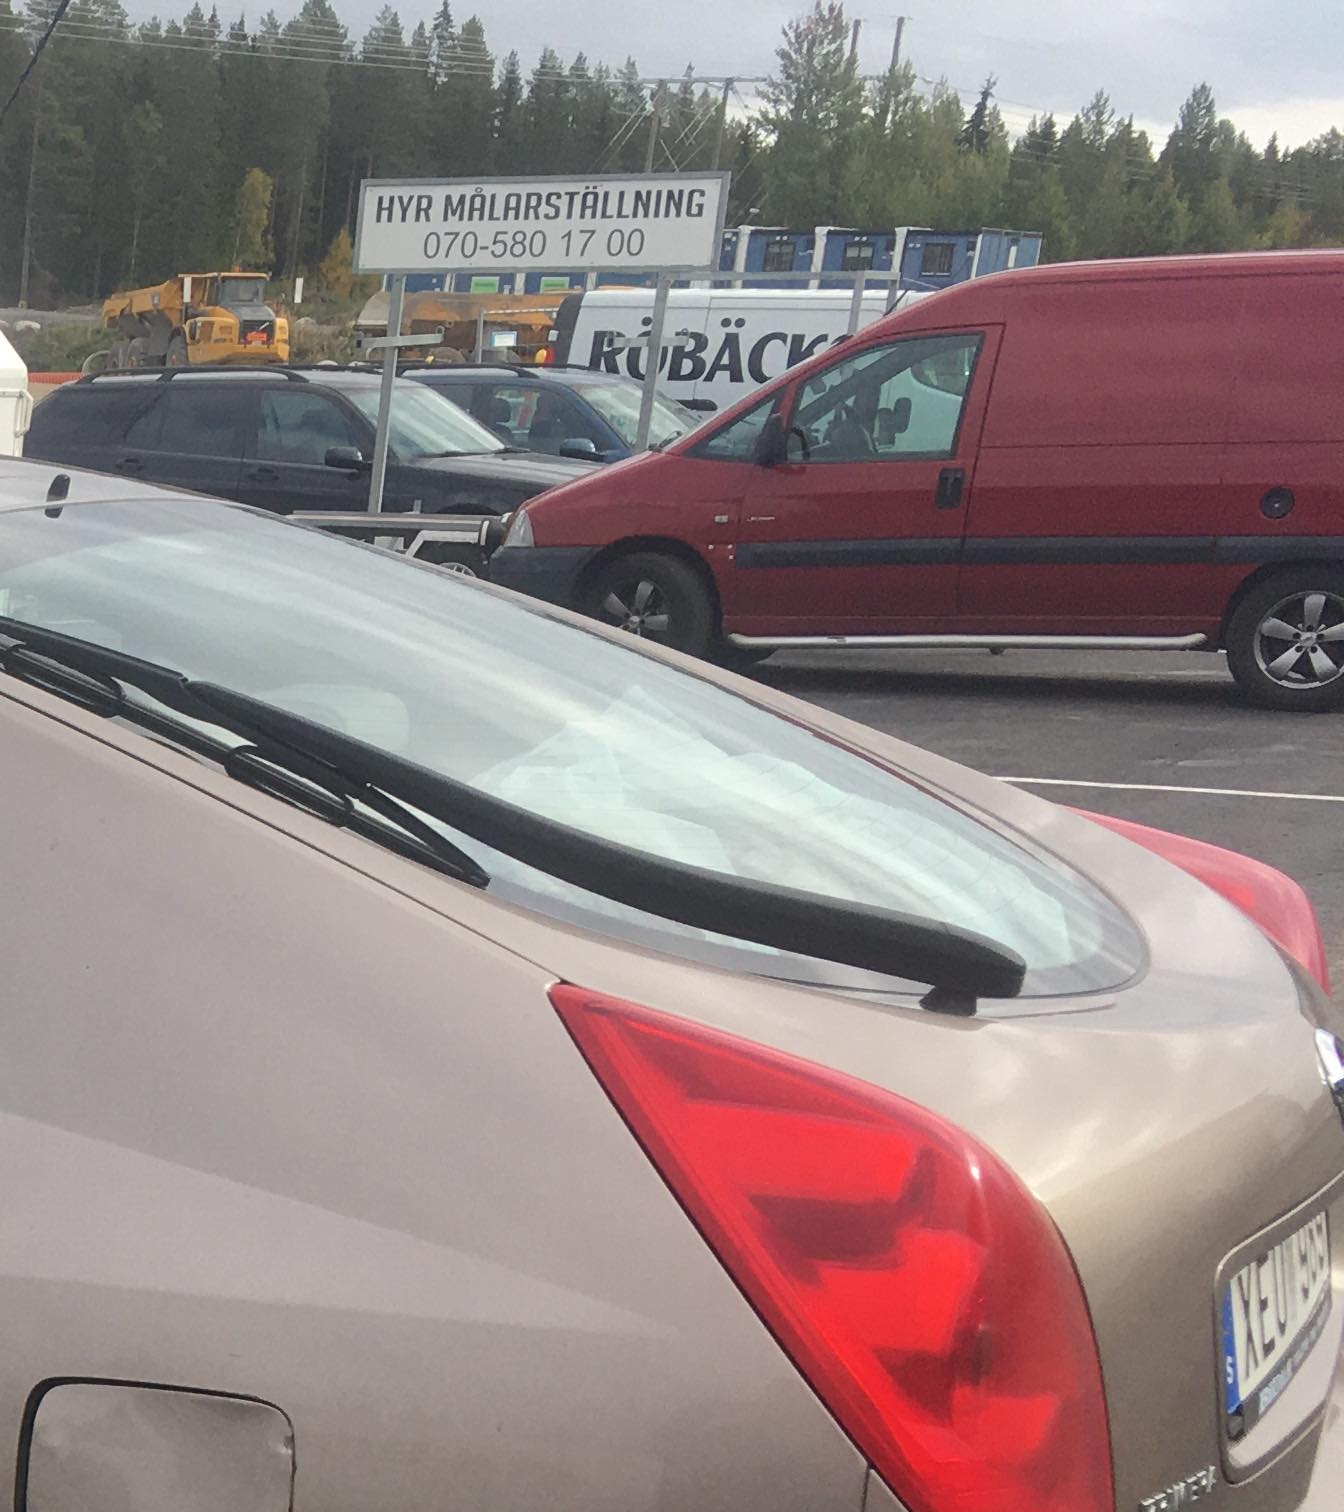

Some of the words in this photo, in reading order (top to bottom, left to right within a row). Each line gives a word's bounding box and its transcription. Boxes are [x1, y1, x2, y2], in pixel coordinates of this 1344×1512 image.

[375, 194, 432, 223] HYR
[443, 185, 706, 222] MÅLARSTÄLLNING
[423, 229, 547, 259] 070-580
[560, 229, 596, 258] 17
[606, 228, 645, 257] 00
[589, 317, 855, 384] RÖBÄCK
